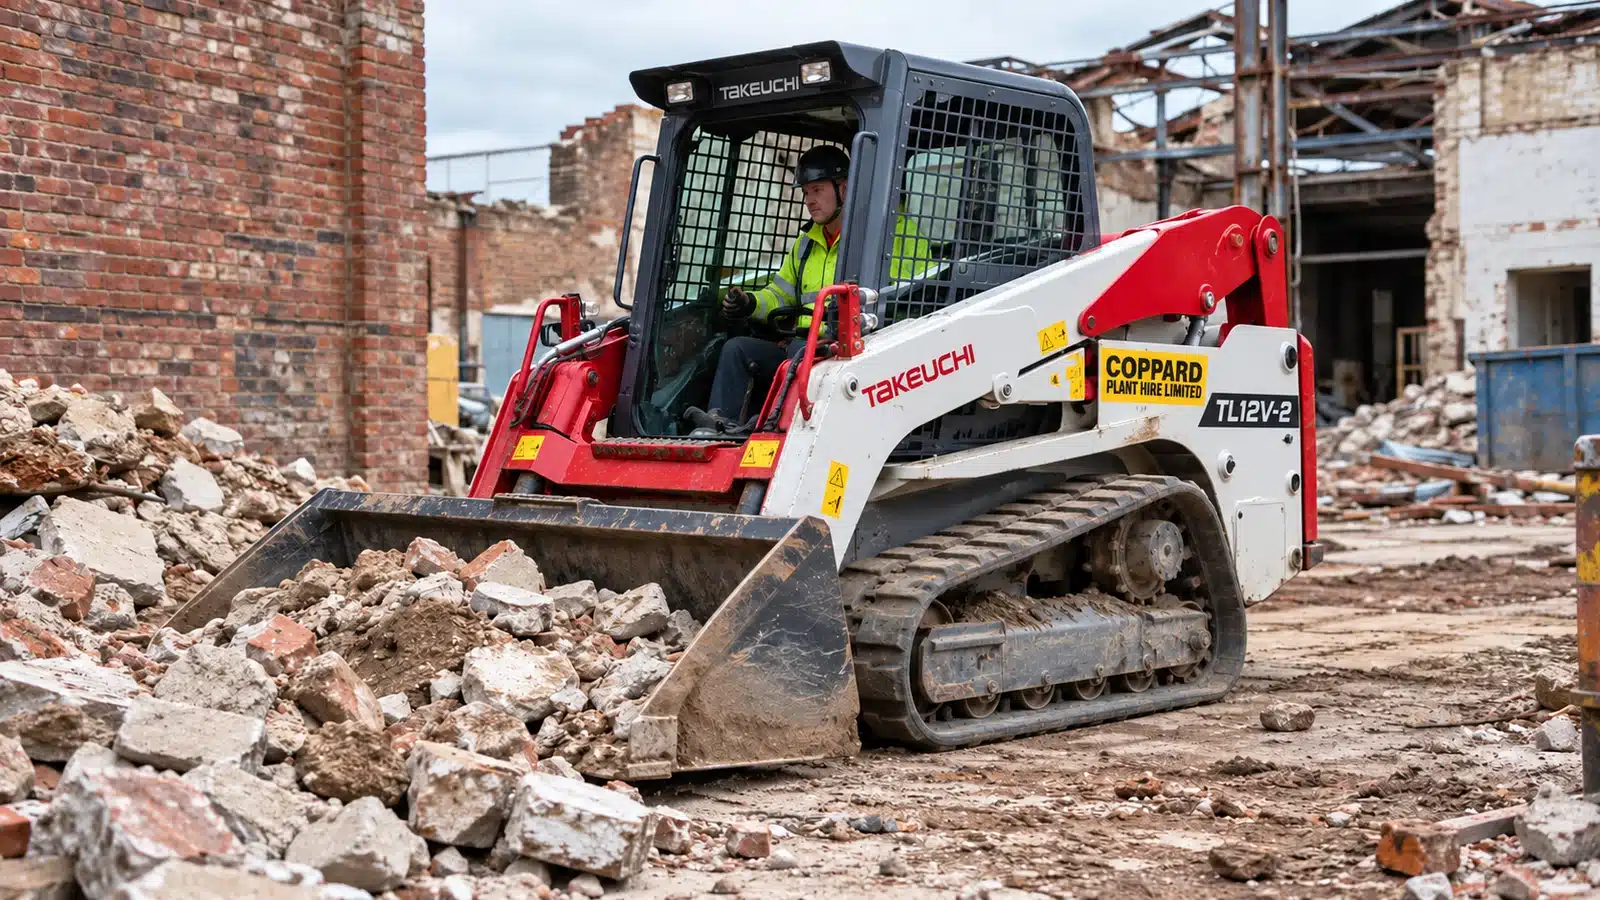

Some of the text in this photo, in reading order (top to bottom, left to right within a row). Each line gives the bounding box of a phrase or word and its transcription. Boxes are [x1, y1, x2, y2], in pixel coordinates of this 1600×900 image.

[1106, 355, 1203, 383] COPPARD
[1106, 380, 1202, 399] PLANT HIRE LIMITED
[1216, 399, 1293, 423] TL12V-2
